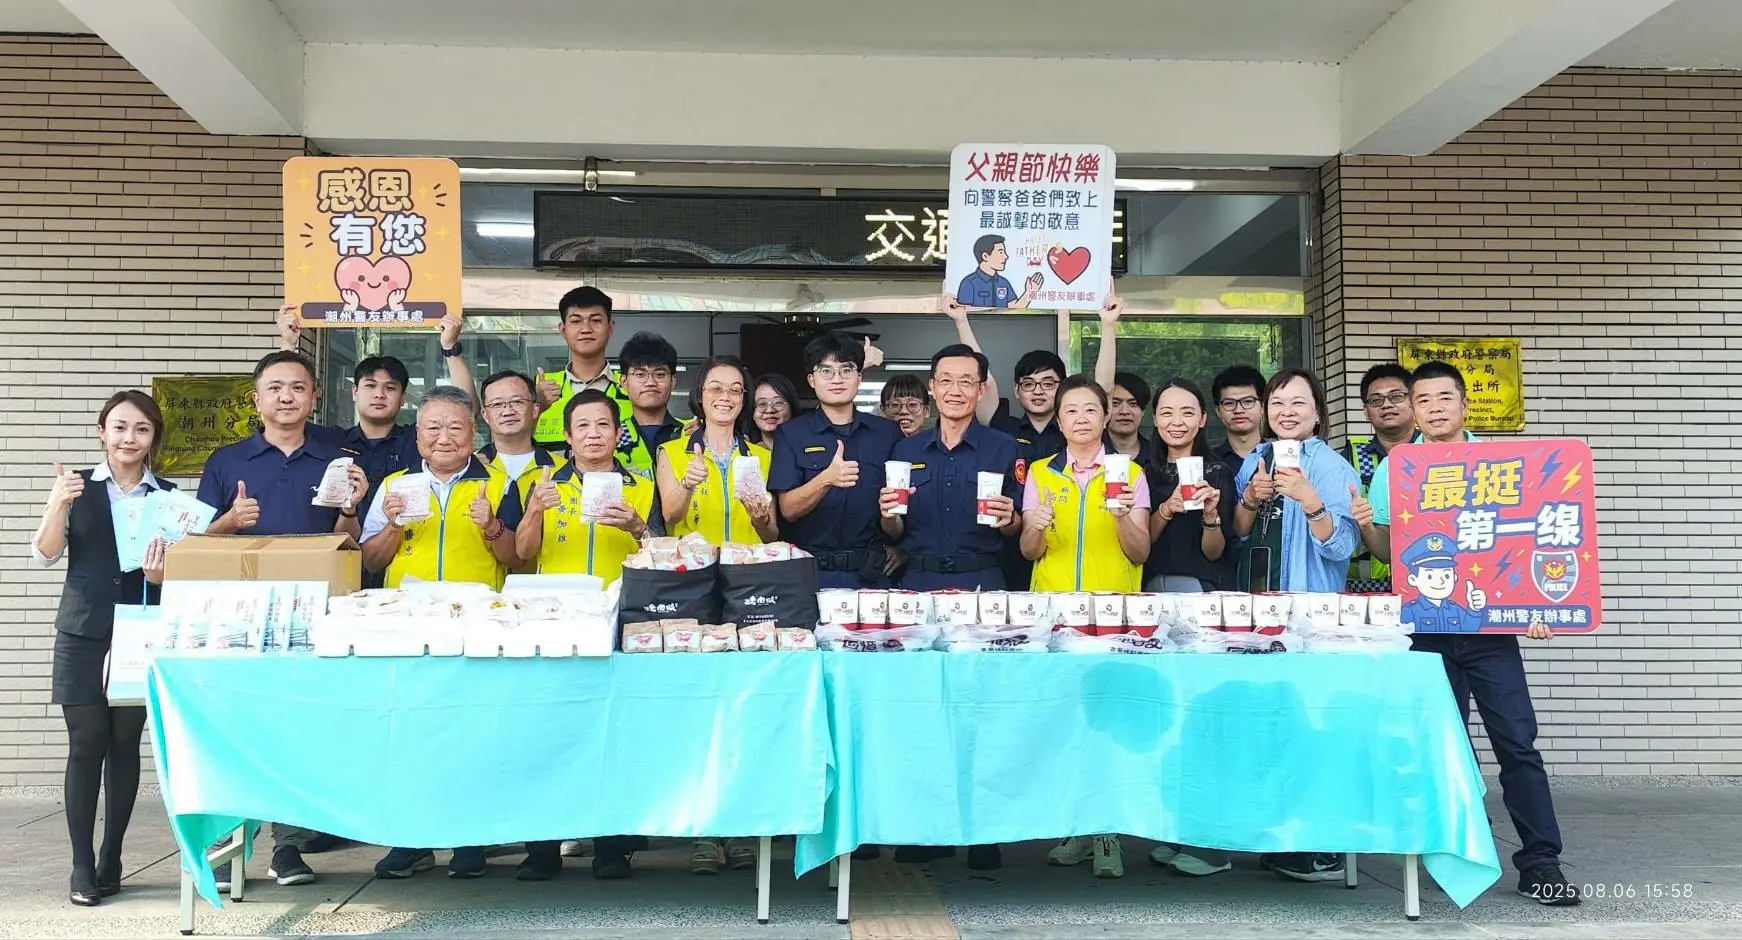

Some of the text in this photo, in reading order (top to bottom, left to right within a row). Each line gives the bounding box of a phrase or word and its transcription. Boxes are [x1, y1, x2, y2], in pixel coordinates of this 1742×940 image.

[965, 152, 1101, 184] 父親節快樂
[317, 167, 414, 214] 感恩
[964, 189, 1099, 208] 向警察爸爸們致上
[980, 211, 1080, 231] 最誠摯的敬意
[329, 212, 427, 256] 有您
[324, 310, 424, 323] 潮州警友辦事處
[1411, 348, 1511, 360] 屏東縣政府警察局
[1465, 364, 1495, 375] 分局
[1472, 380, 1500, 393] 出所
[179, 415, 260, 430] 潮州分局
[1420, 459, 1524, 511] 最挺
[1457, 502, 1582, 552] 第一線
[1544, 582, 1569, 592] POLICE
[1488, 608, 1587, 625] 潮州警友辦事處
